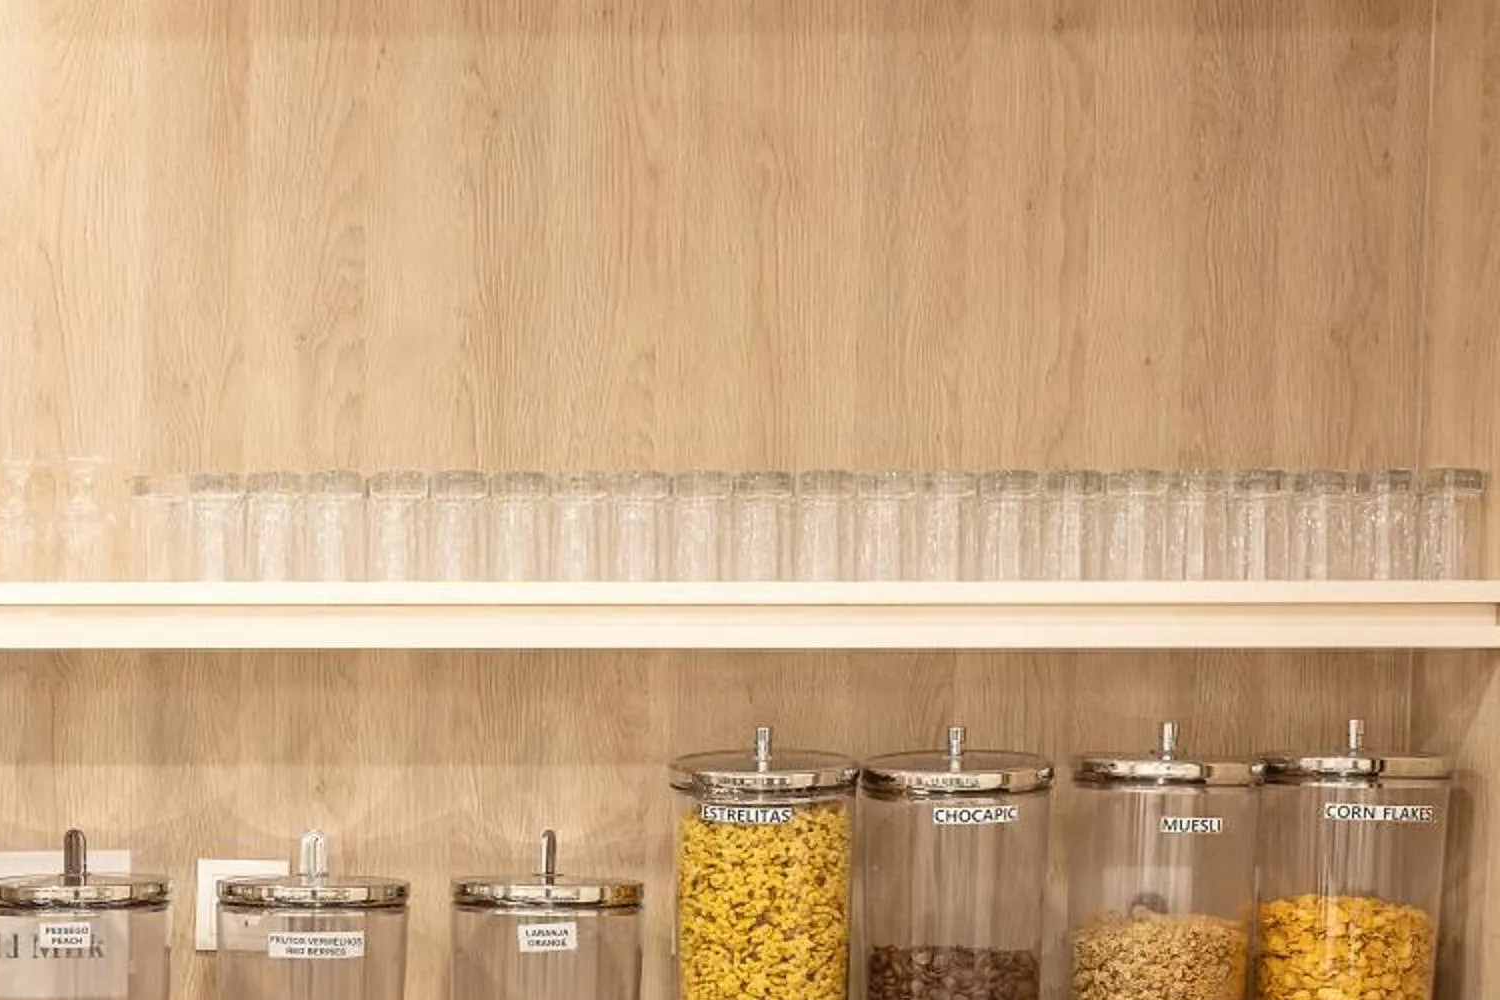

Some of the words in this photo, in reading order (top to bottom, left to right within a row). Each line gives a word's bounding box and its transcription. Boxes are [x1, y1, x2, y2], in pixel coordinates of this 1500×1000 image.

[703, 805, 792, 823] ESTRELITAS
[934, 807, 1017, 823] CHOCAPIC
[1326, 805, 1376, 819] CORN
[1382, 806, 1433, 822] FLAKES
[1162, 818, 1222, 833] MUESLI
[51, 937, 83, 945] PEACH
[269, 935, 306, 945] FRUTOS
